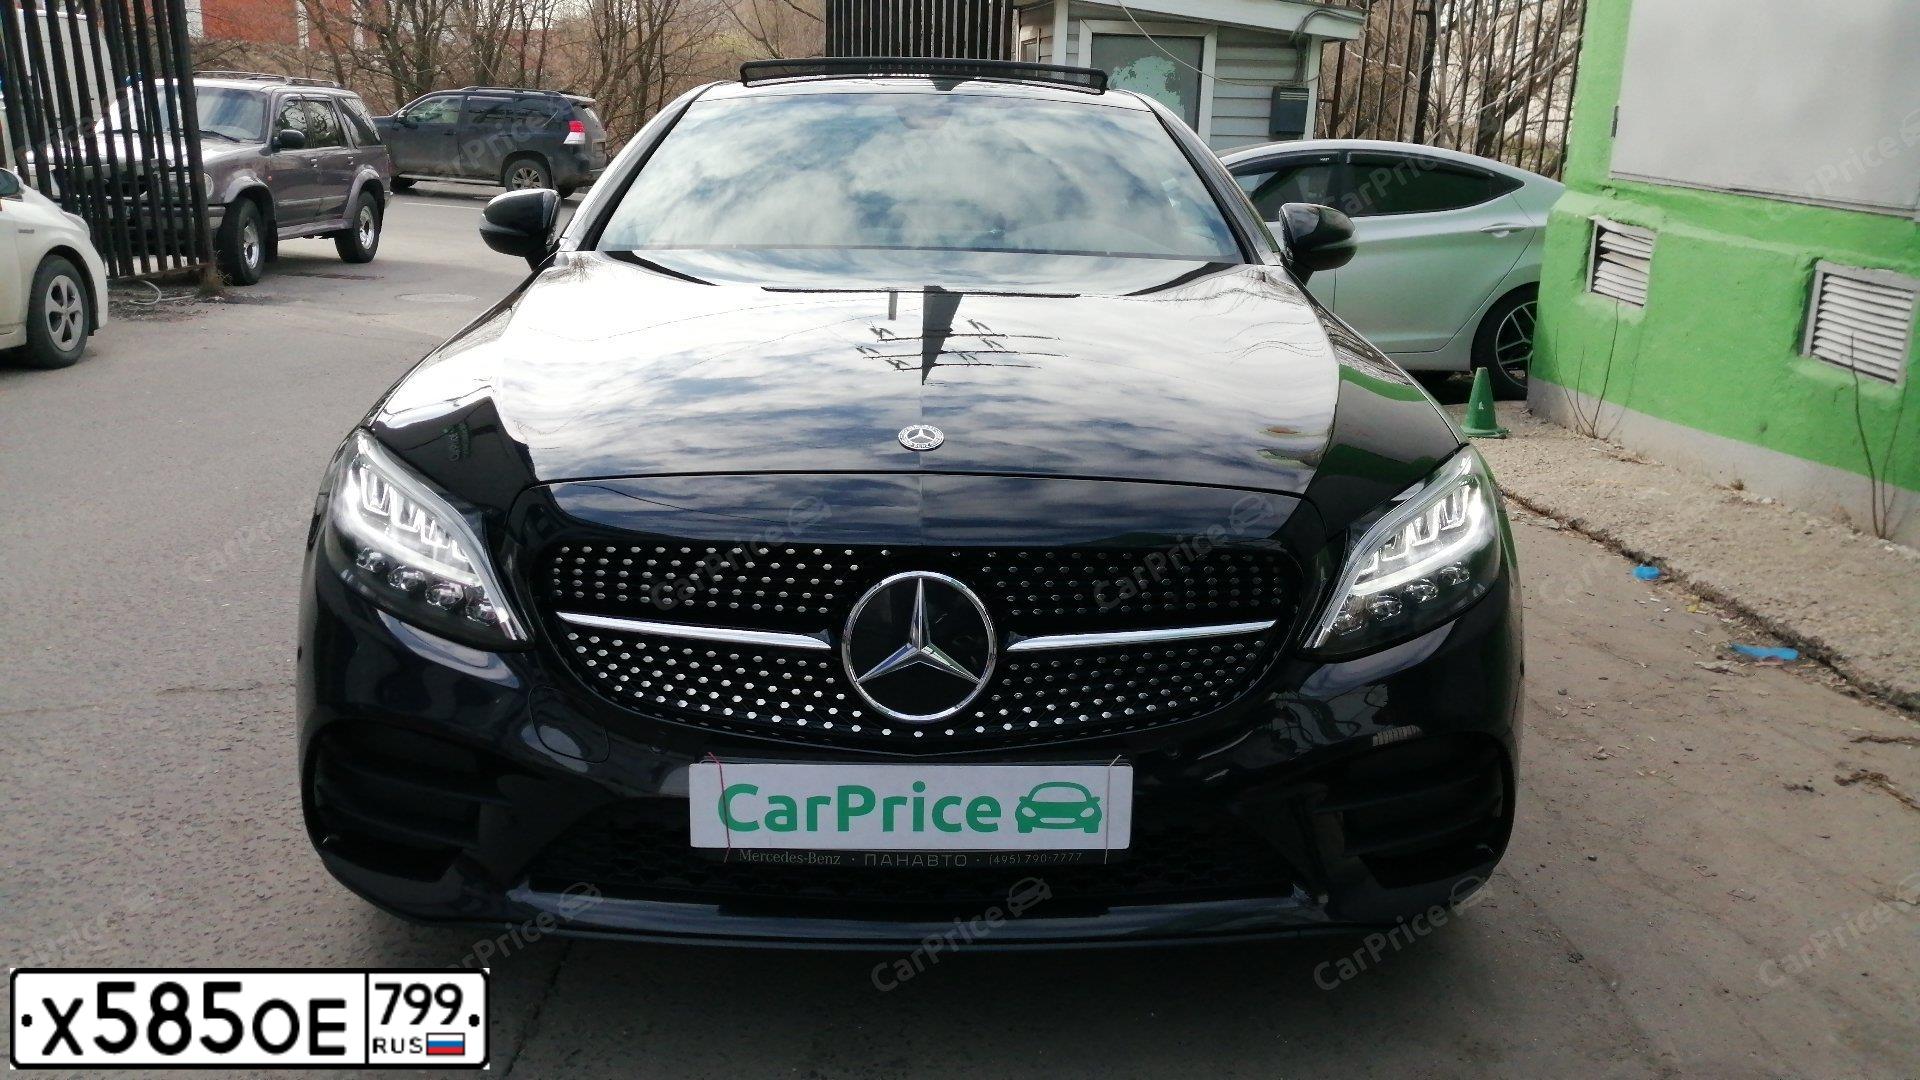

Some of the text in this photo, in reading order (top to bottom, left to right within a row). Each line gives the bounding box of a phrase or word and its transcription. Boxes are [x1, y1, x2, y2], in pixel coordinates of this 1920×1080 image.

[718, 780, 1001, 833] CarPrice
[738, 849, 841, 865] Mercedes-Benz
[864, 853, 967, 867] ПАНАВТО
